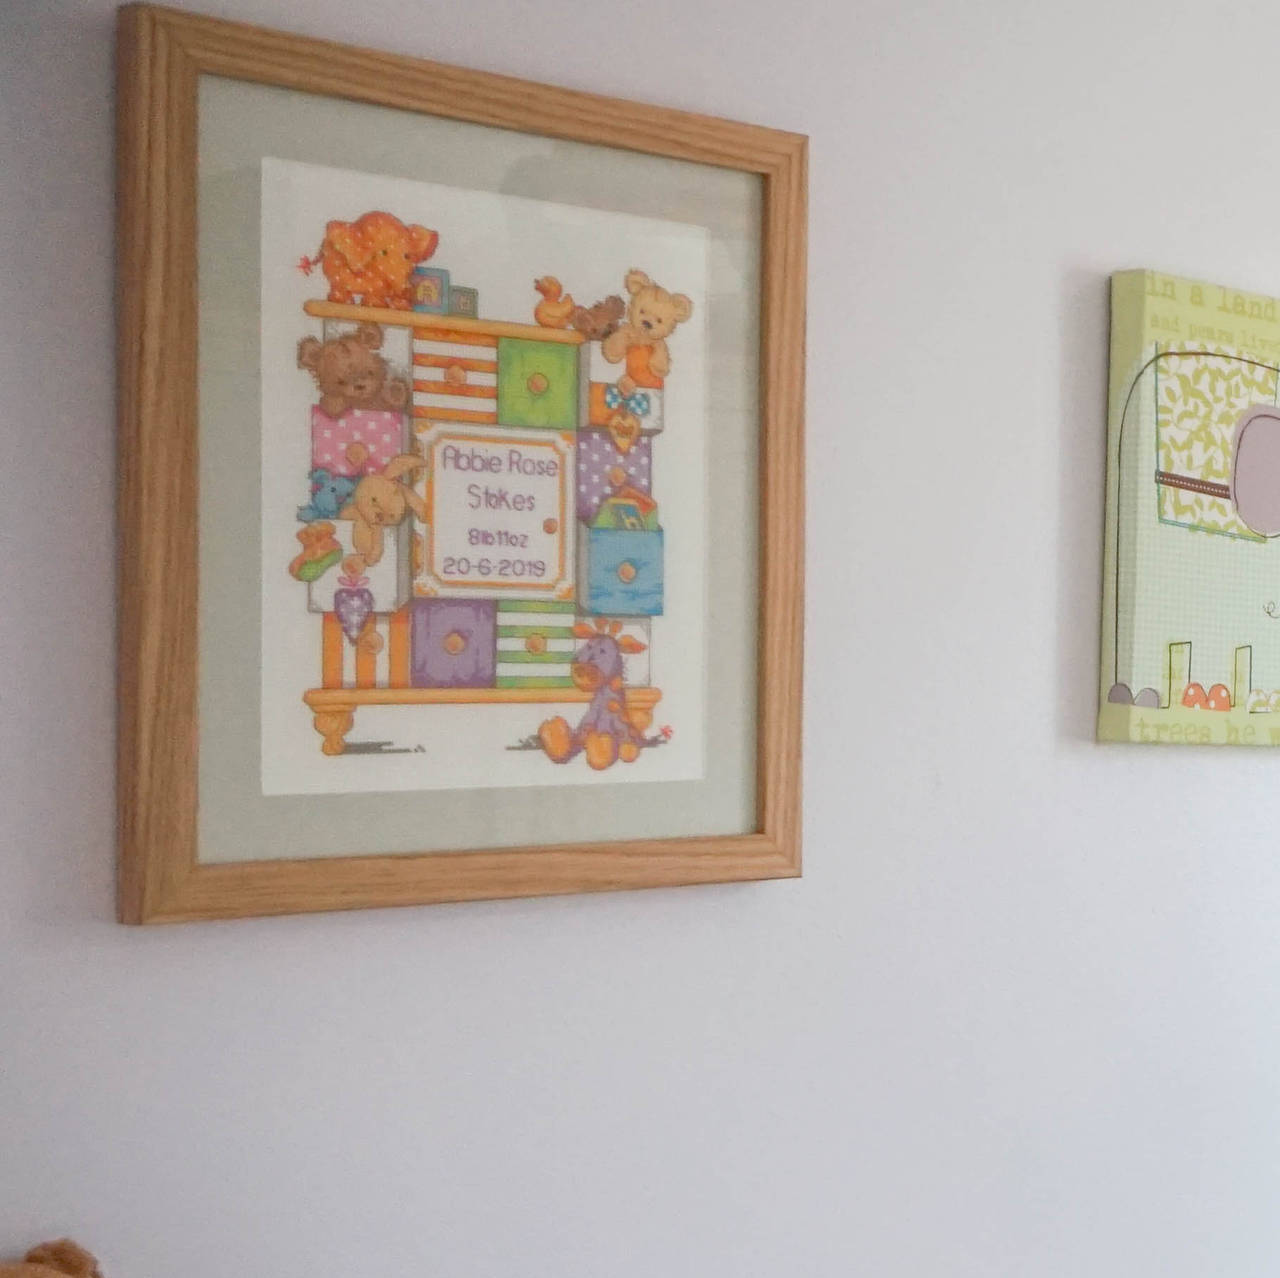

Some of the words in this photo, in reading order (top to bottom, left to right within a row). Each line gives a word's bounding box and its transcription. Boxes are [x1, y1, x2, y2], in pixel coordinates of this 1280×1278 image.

[1145, 271, 1176, 301] in
[1190, 284, 1204, 307] a
[1216, 286, 1278, 323] land
[442, 445, 503, 473] Abbie
[508, 449, 559, 477] Rose
[443, 556, 547, 578] 20-6-2019
[1135, 718, 1212, 745] trees
[1226, 720, 1256, 746] he
